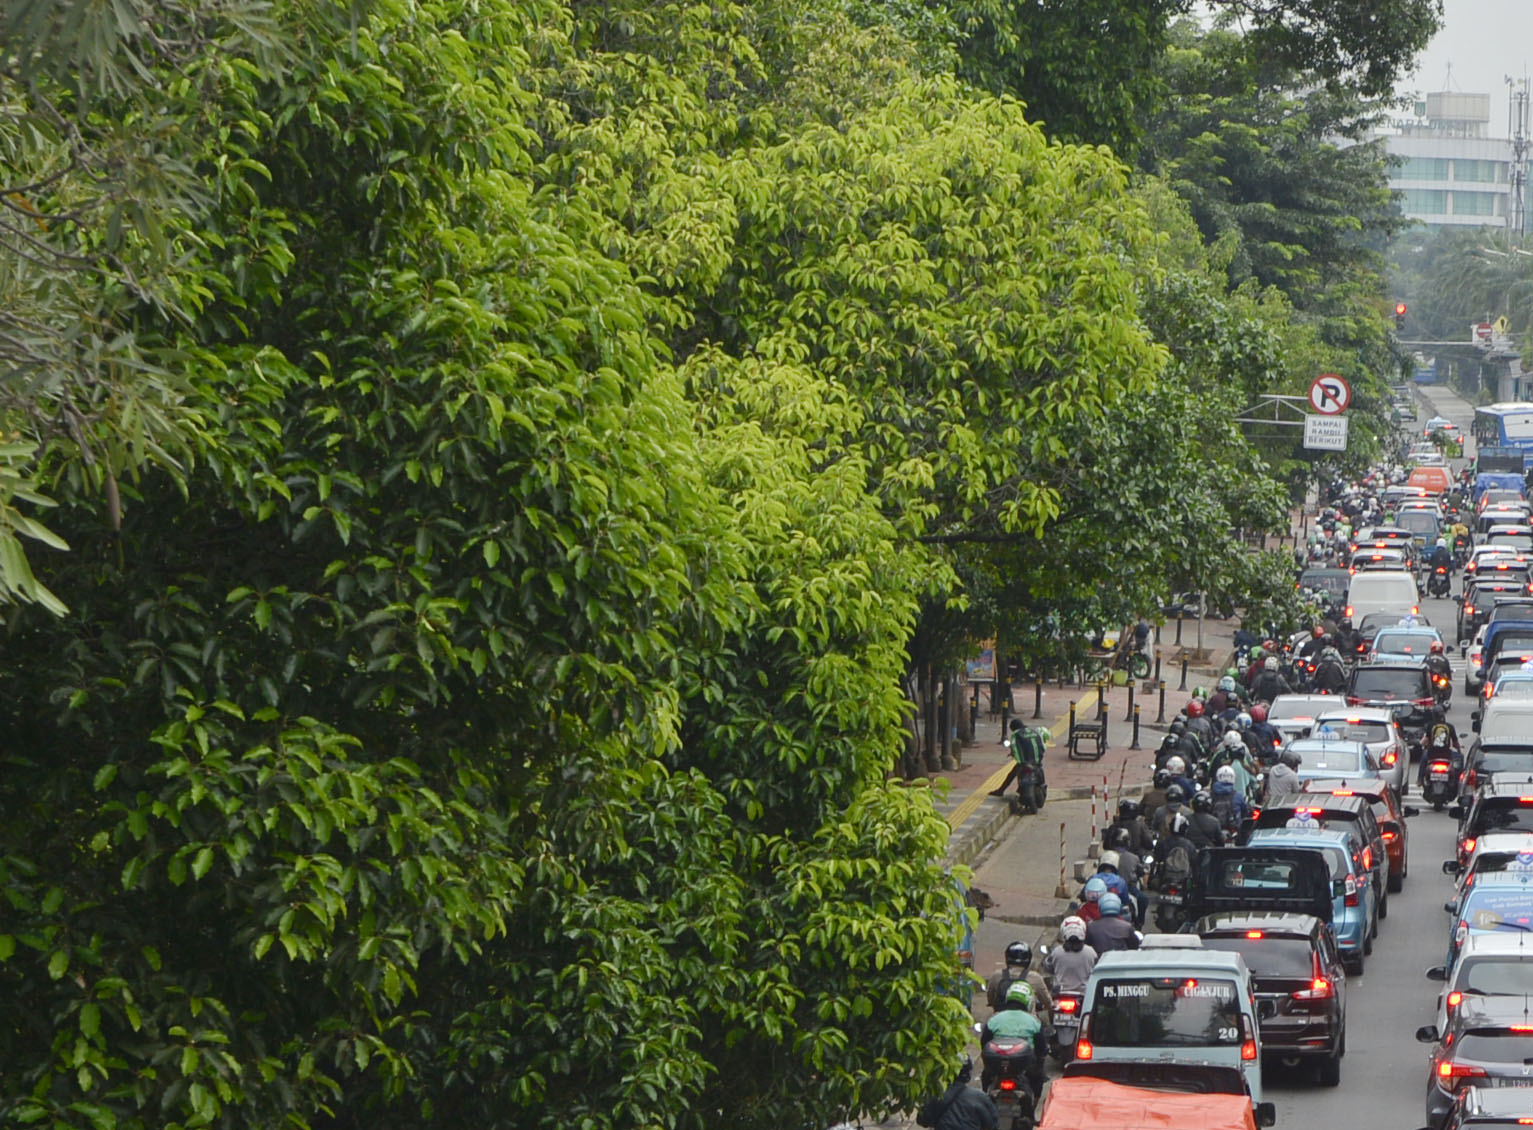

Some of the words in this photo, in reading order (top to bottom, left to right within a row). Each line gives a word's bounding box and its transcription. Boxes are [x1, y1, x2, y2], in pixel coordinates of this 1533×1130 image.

[1311, 420, 1341, 428] SAMPAI
[1308, 436, 1343, 445] BERIKUT
[1184, 986, 1230, 998] CIGANJUR
[1218, 1027, 1238, 1039] 20
